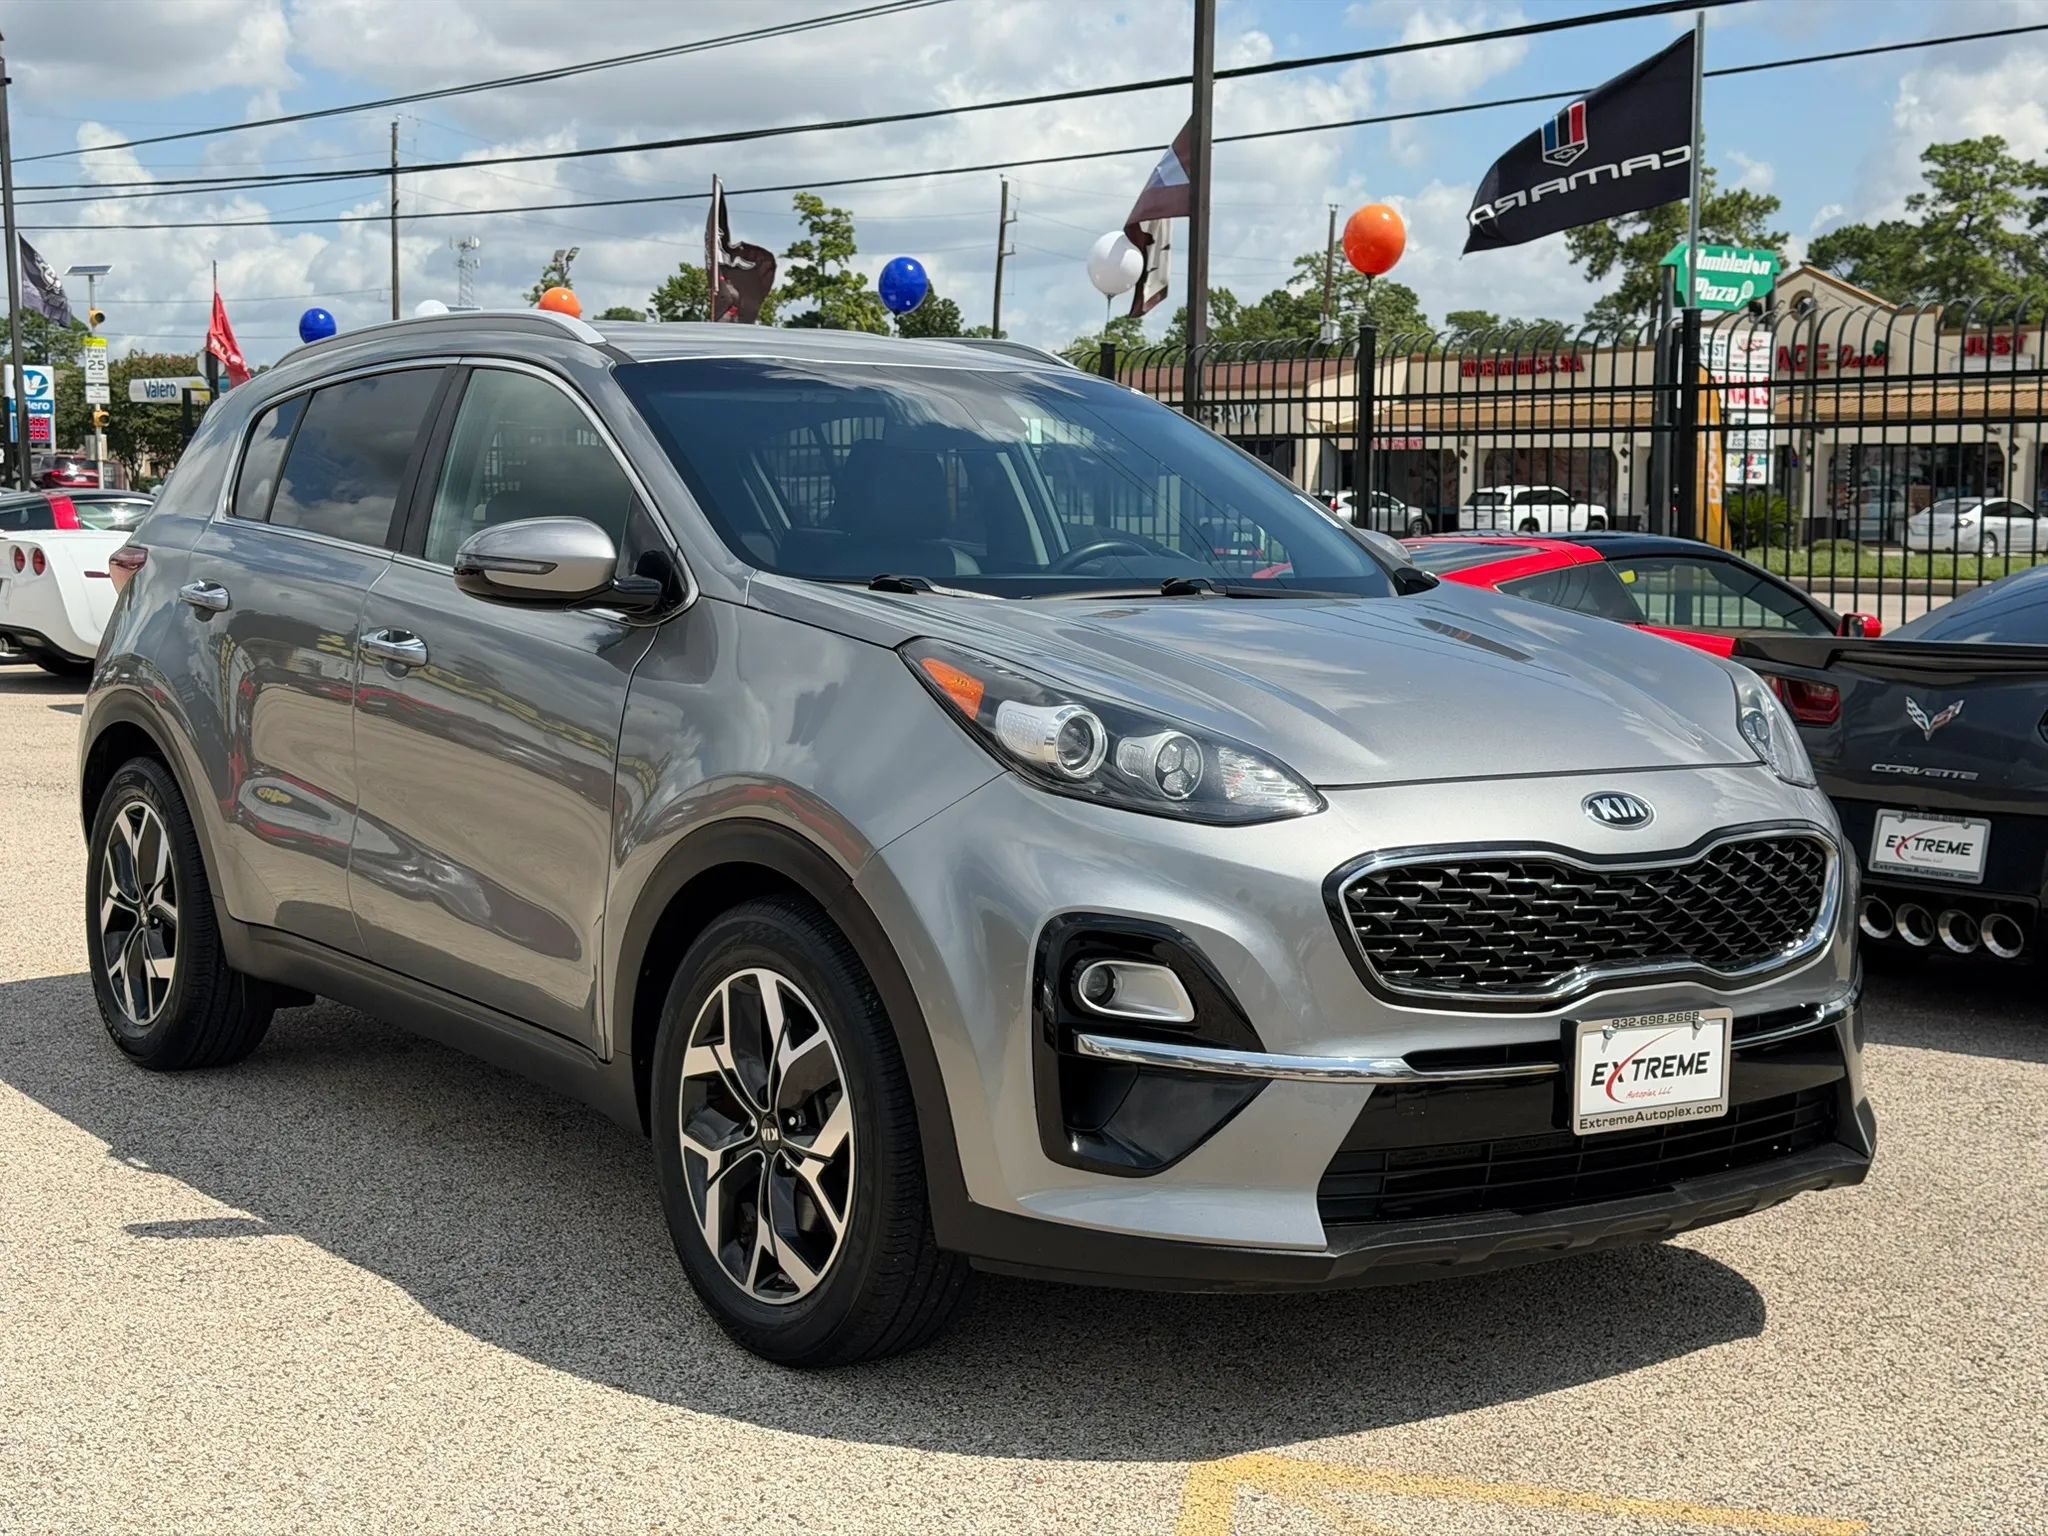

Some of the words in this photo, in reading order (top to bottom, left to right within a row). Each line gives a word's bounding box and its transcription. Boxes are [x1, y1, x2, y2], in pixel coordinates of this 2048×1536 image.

[1695, 276, 1739, 303] Plaza
[88, 359, 106, 371] 25
[143, 379, 177, 398] Valero
[1728, 376, 1770, 405] NALS
[1871, 763, 1979, 781] CORVETTE
[1592, 797, 1647, 820] KIA
[1885, 834, 1974, 857] EXTREME
[1590, 1051, 1711, 1087] EXTREME
[1579, 1102, 1723, 1131] ExtremeAutoplex.com
